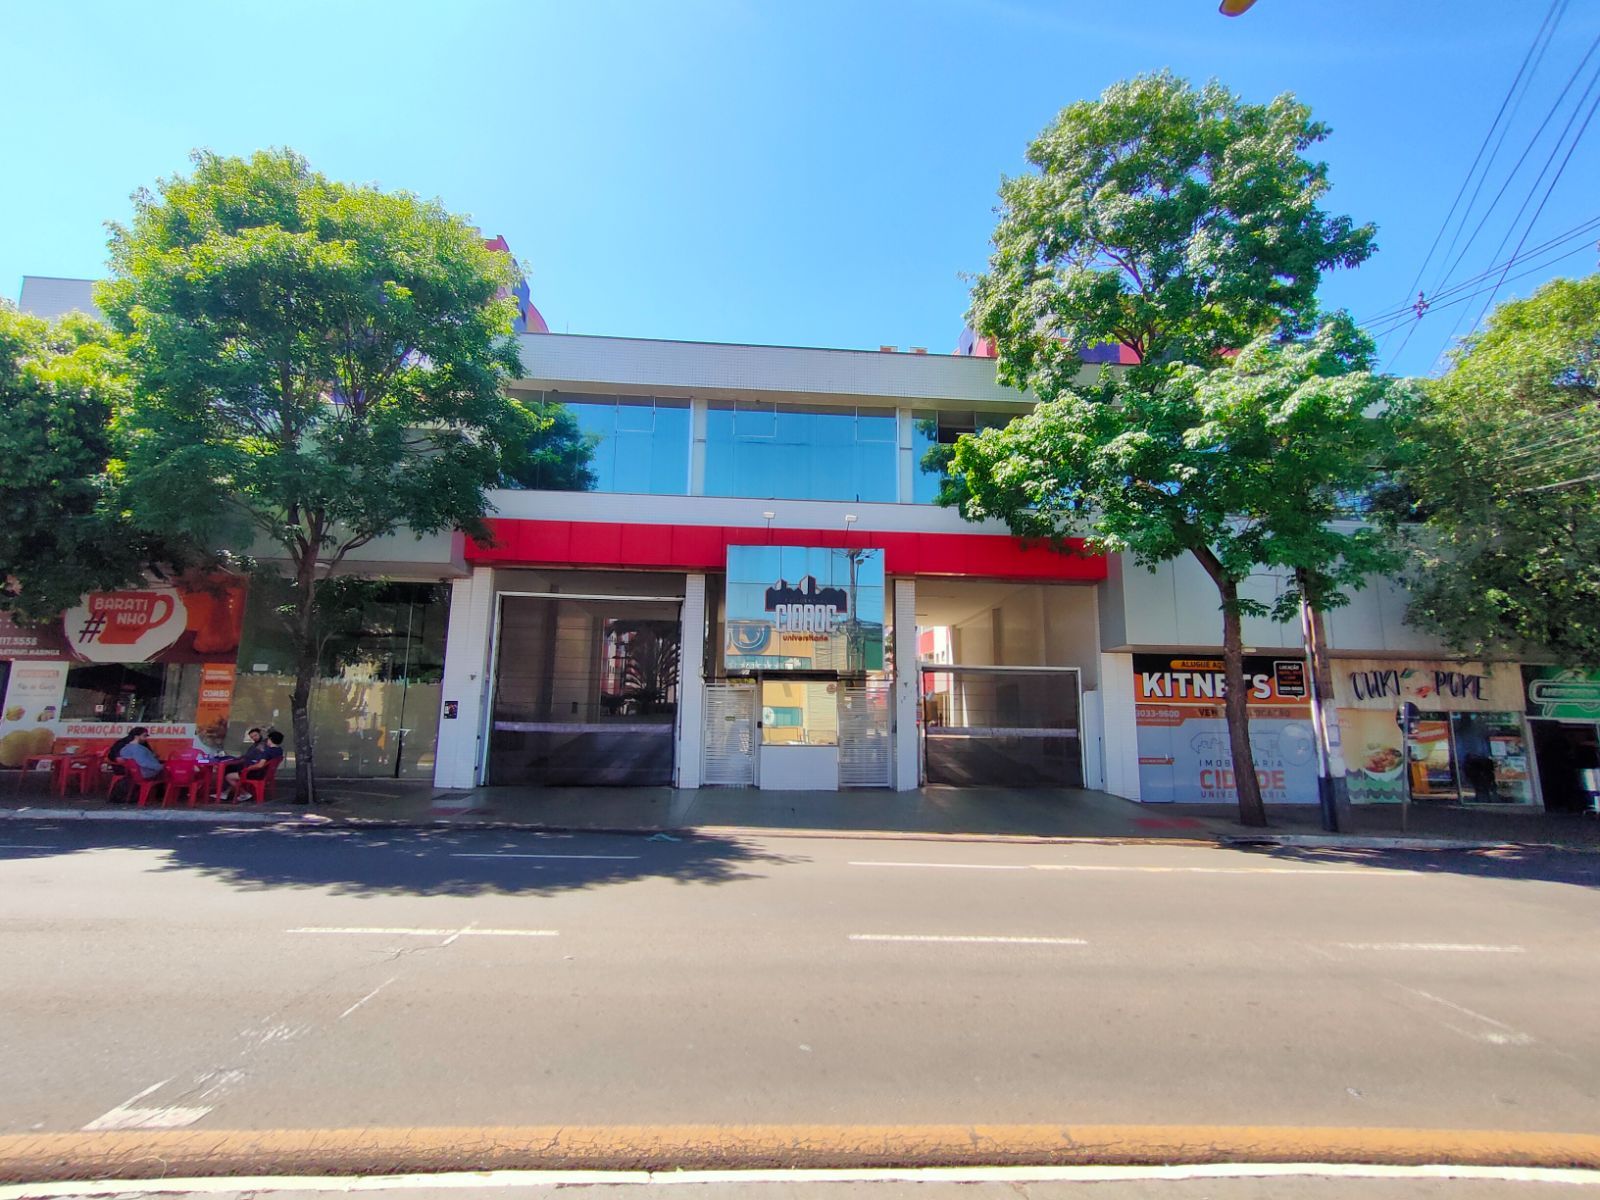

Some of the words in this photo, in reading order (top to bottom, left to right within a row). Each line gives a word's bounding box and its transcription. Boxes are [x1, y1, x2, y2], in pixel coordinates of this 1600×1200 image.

[94, 598, 148, 610] BARATI
[116, 612, 147, 624] NHO
[775, 604, 837, 632] CIDADE
[1199, 759, 1284, 768] IMOBARIA
[1200, 769, 1287, 790] CIDDE
